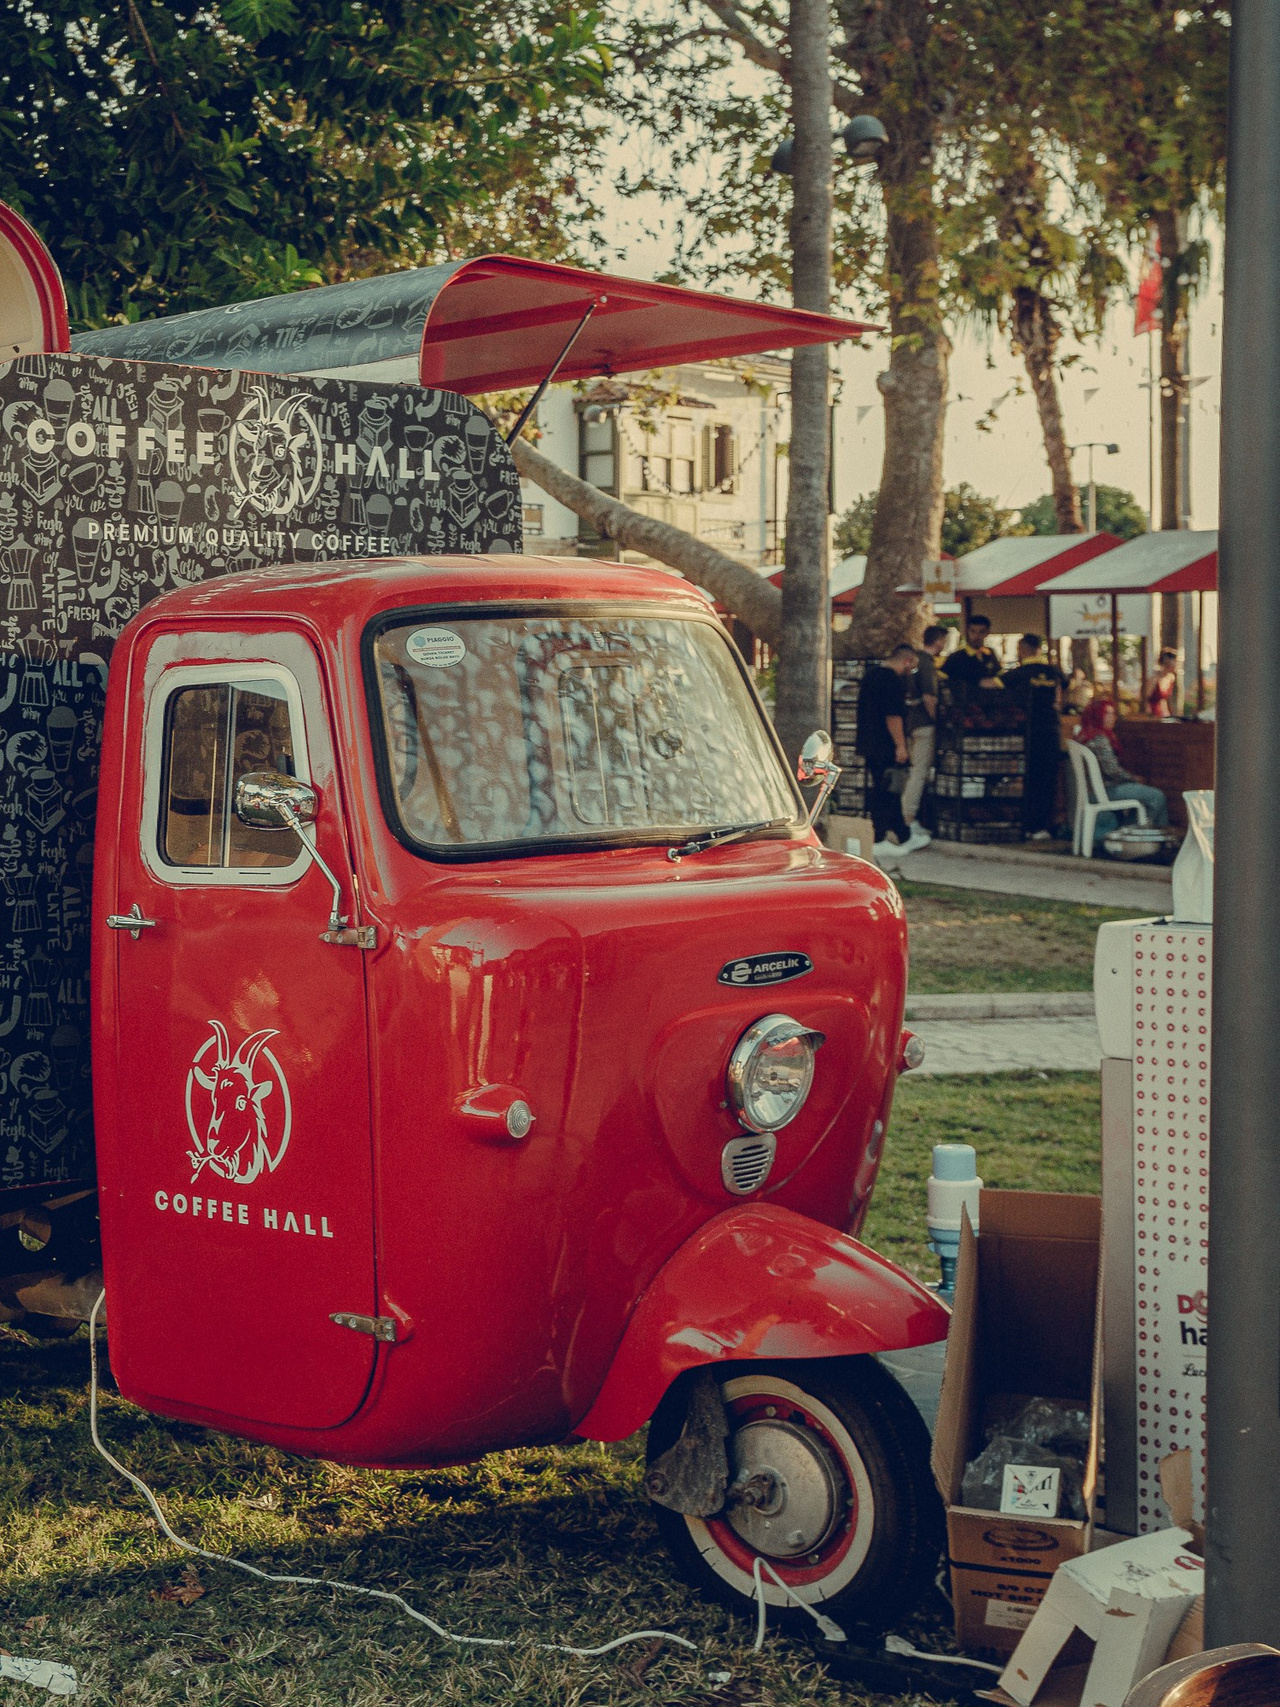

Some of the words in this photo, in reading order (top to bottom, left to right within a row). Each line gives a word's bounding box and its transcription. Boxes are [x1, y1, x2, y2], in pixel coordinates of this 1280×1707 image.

[93, 395, 122, 425] ALL
[26, 418, 215, 465] COFFEE
[334, 443, 441, 481] HALL
[88, 522, 194, 544] PREMIUM
[205, 527, 301, 549] QUALITY
[311, 533, 391, 553] COFFEE
[52, 659, 84, 687] ALL
[154, 1190, 250, 1225] COFFEE
[263, 1208, 334, 1239] HALL
[970, 1589, 1003, 1599] HOT
